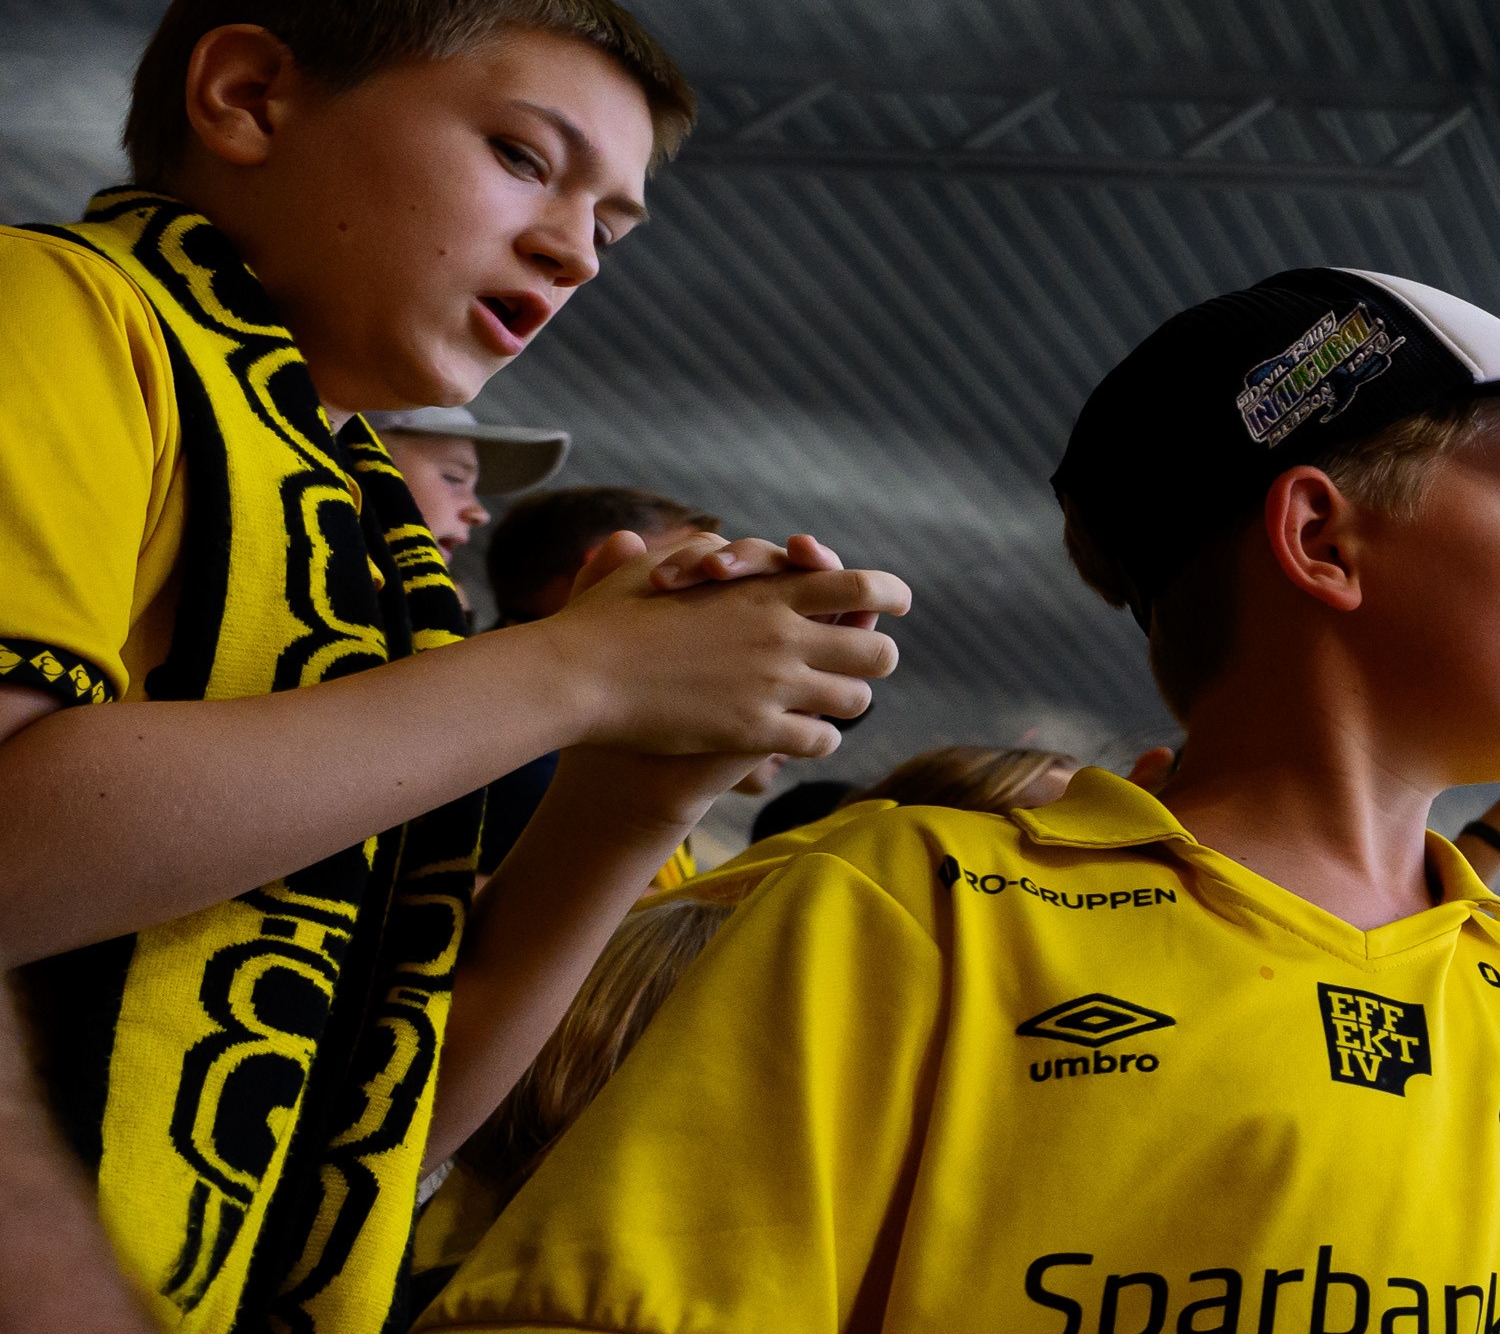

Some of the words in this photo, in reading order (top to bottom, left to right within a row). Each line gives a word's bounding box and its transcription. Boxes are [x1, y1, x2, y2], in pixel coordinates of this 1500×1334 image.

[1249, 311, 1374, 436] INAUGURAL
[962, 867, 1177, 911] RO-GRUPPEN
[1326, 990, 1405, 1033] EFF
[1331, 1017, 1421, 1065] EKT
[1029, 1050, 1161, 1083] umbro
[1337, 1046, 1383, 1083] IV
